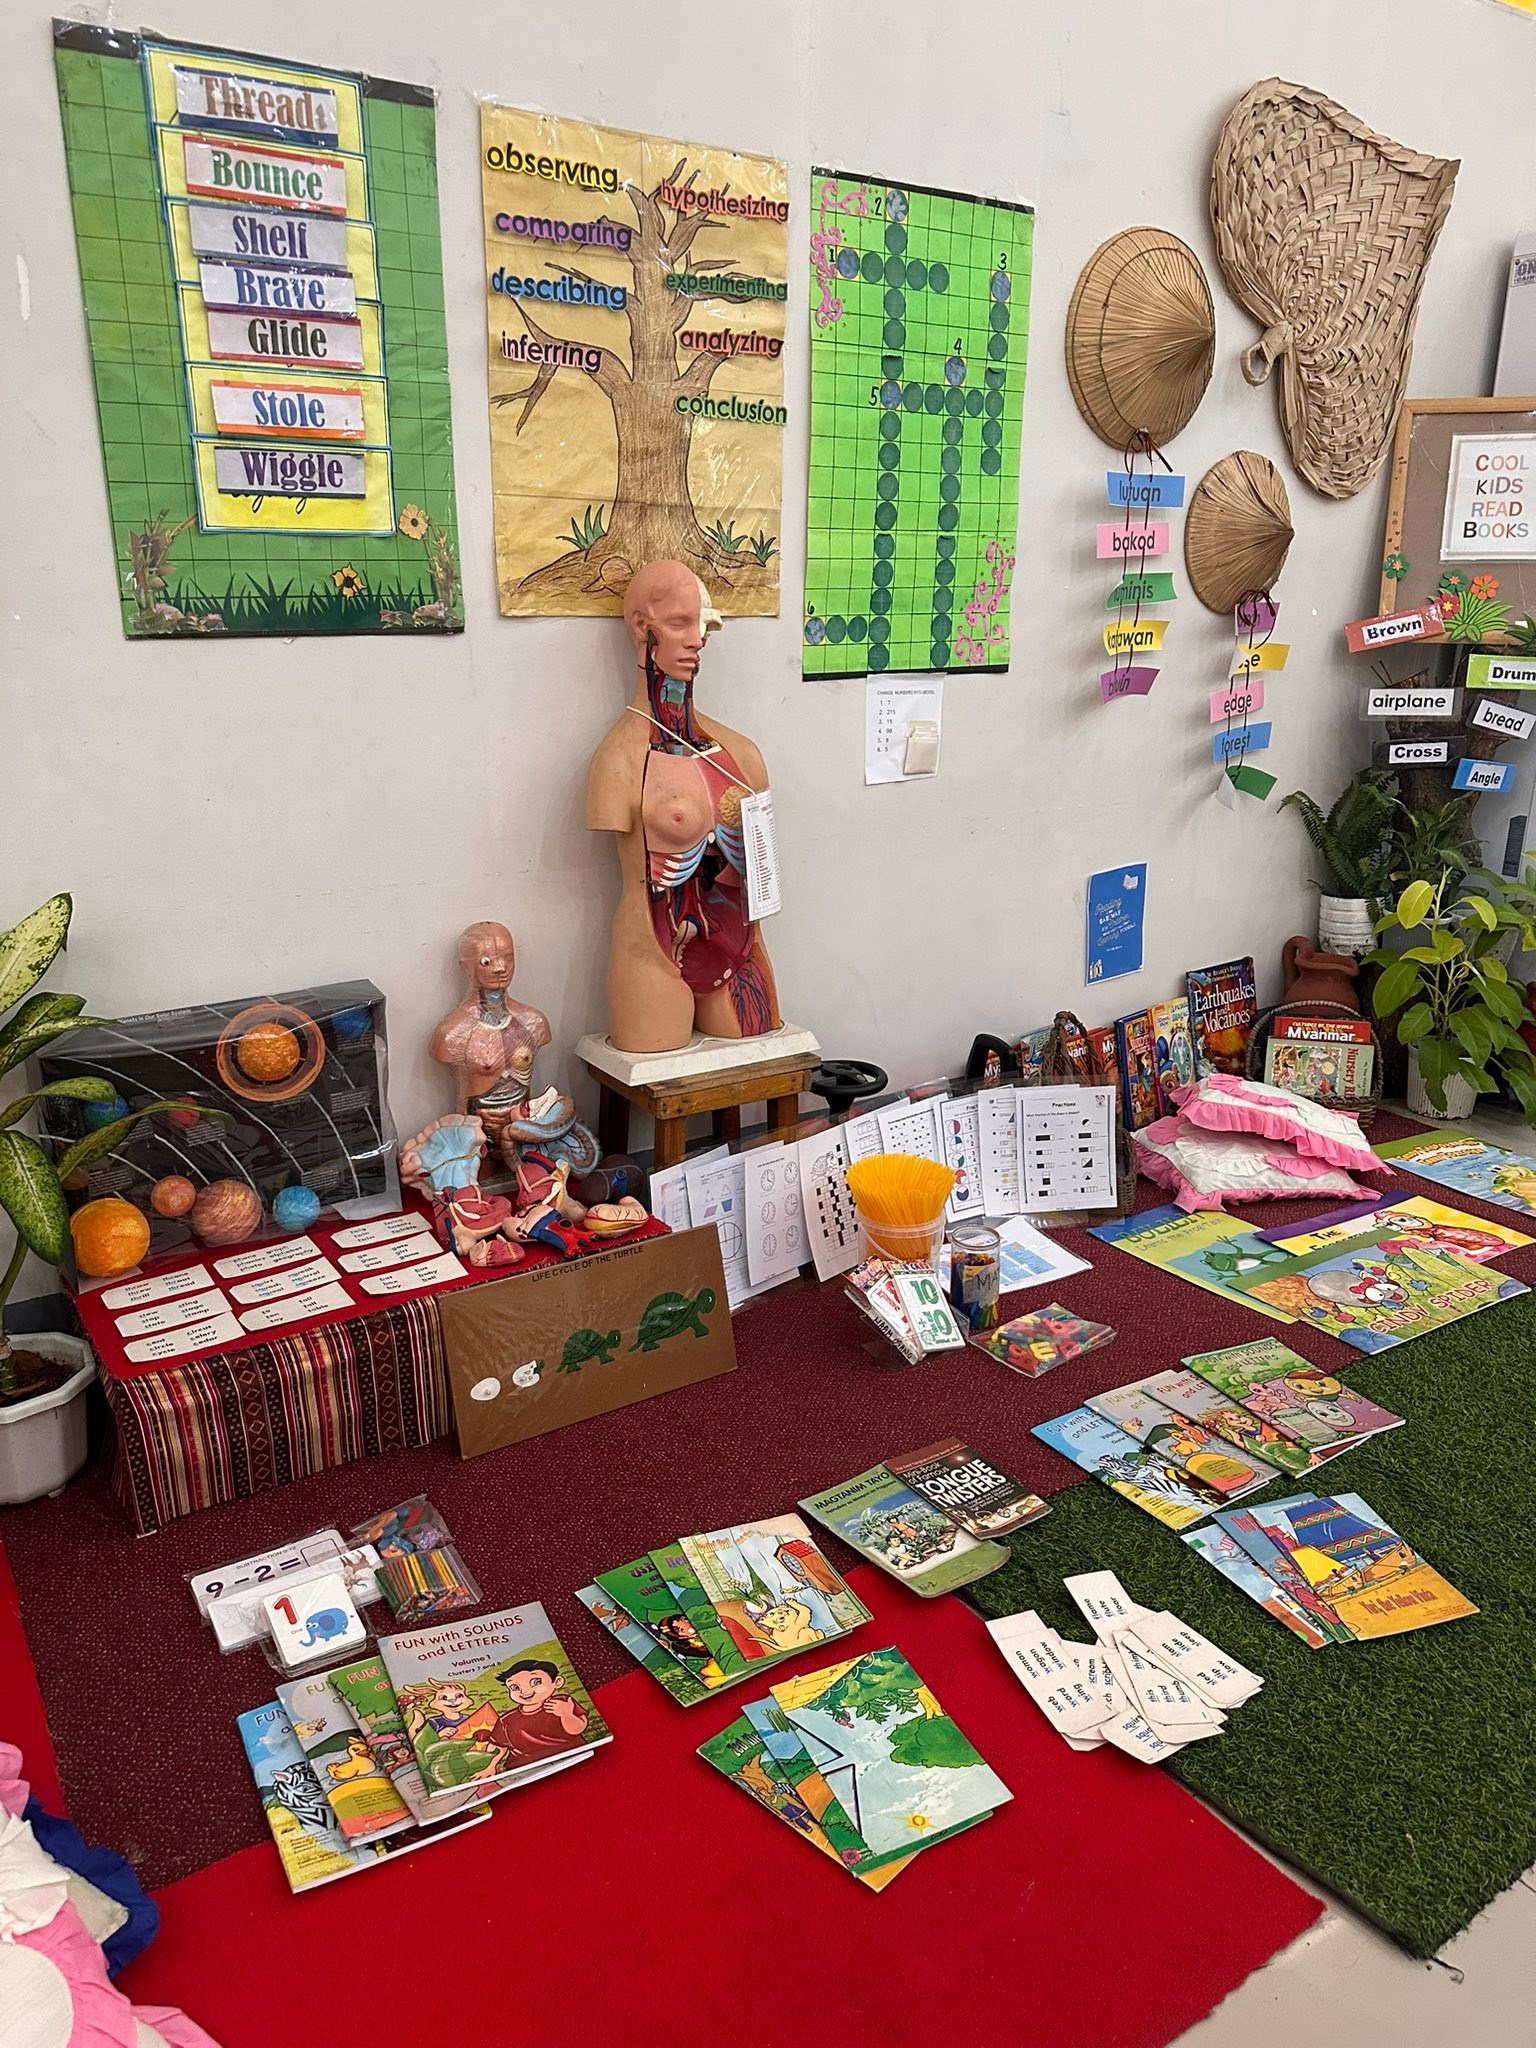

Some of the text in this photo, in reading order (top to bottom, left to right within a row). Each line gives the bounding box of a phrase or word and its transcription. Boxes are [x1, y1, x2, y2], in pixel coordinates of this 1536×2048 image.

[200, 76, 312, 131] Thread
[212, 149, 324, 202] Bounce
[486, 143, 618, 193] observing
[661, 179, 790, 222] hypothesizing
[874, 197, 882, 216] 2
[232, 214, 309, 260] Shelf
[495, 212, 632, 252] comparing
[829, 249, 835, 263] 1
[998, 253, 1007, 271] 3
[235, 267, 326, 311] Brave
[492, 267, 628, 311] describing
[665, 272, 788, 302] experimenting
[247, 318, 328, 360] Glide
[680, 329, 784, 359] analyzing
[954, 337, 962, 355] 4
[502, 332, 602, 373] inferring
[869, 386, 879, 406] 5
[252, 390, 326, 428] Stole
[676, 396, 787, 425] conclusion
[240, 451, 343, 492] Wiggle
[1475, 453, 1530, 472] COOL
[1475, 476, 1524, 497] KIDS
[1471, 501, 1523, 517] READ
[1463, 521, 1529, 538] BOOKS
[1112, 530, 1155, 551] bakod
[1366, 618, 1422, 642] Brown
[1491, 666, 1536, 681] Drum
[1223, 694, 1252, 714] edge
[1372, 692, 1447, 711] airplane
[1482, 708, 1525, 733] bread
[1221, 734, 1251, 756] forest
[1394, 745, 1442, 759] Cross
[1469, 770, 1501, 787] Angle
[1194, 978, 1255, 1013] Earthquakes
[1202, 1008, 1251, 1034] Volcanoes
[1343, 1048, 1358, 1084] Nursery
[532, 1246, 644, 1282] LIFE CYCLE OF THE TURTLE
[910, 1278, 940, 1306] 10
[1368, 1279, 1495, 1334] CINDY SPIDER
[1242, 1353, 1280, 1368] LETTERS
[1156, 1376, 1193, 1394] FUN with
[1182, 1388, 1195, 1399] and
[1105, 1393, 1126, 1405] FUN
[1046, 1414, 1087, 1436] FUN with
[1072, 1428, 1090, 1439] and
[902, 1461, 941, 1478] Mini-Book
[908, 1466, 950, 1485] of Famous
[917, 1458, 993, 1496] TONGUE
[814, 1483, 867, 1510] MAGTANIM
[867, 1471, 890, 1490] TAYO
[930, 1470, 1007, 1508] TWISTERS
[236, 1551, 282, 1570] SUBTRACTION
[206, 1564, 276, 1598] 9 2
[274, 1596, 298, 1625] 1
[1084, 1598, 1103, 1620] flame
[1099, 1600, 1116, 1618] flute
[1110, 1596, 1128, 1616] floor
[394, 1614, 524, 1651] FUN with SOUNDS
[1180, 1632, 1202, 1647] sleep
[417, 1634, 510, 1661] and LETTERS
[1040, 1641, 1067, 1670] window
[1162, 1642, 1182, 1658] slam
[1172, 1638, 1192, 1652] slide
[452, 1656, 485, 1668] Volume
[1016, 1650, 1040, 1679] woman
[1030, 1648, 1054, 1674] wagon
[1088, 1658, 1098, 1684] scream
[1217, 1660, 1238, 1674] slow
[348, 1666, 380, 1685] FUN
[448, 1667, 476, 1677] Clusters
[1196, 1672, 1218, 1686] sled
[1212, 1668, 1228, 1680] slip
[1056, 1687, 1080, 1708] word
[1073, 1683, 1093, 1702] wing
[1146, 1689, 1160, 1702] this
[1158, 1685, 1176, 1702] third
[1048, 1696, 1066, 1713] web
[256, 1709, 288, 1726] FUN
